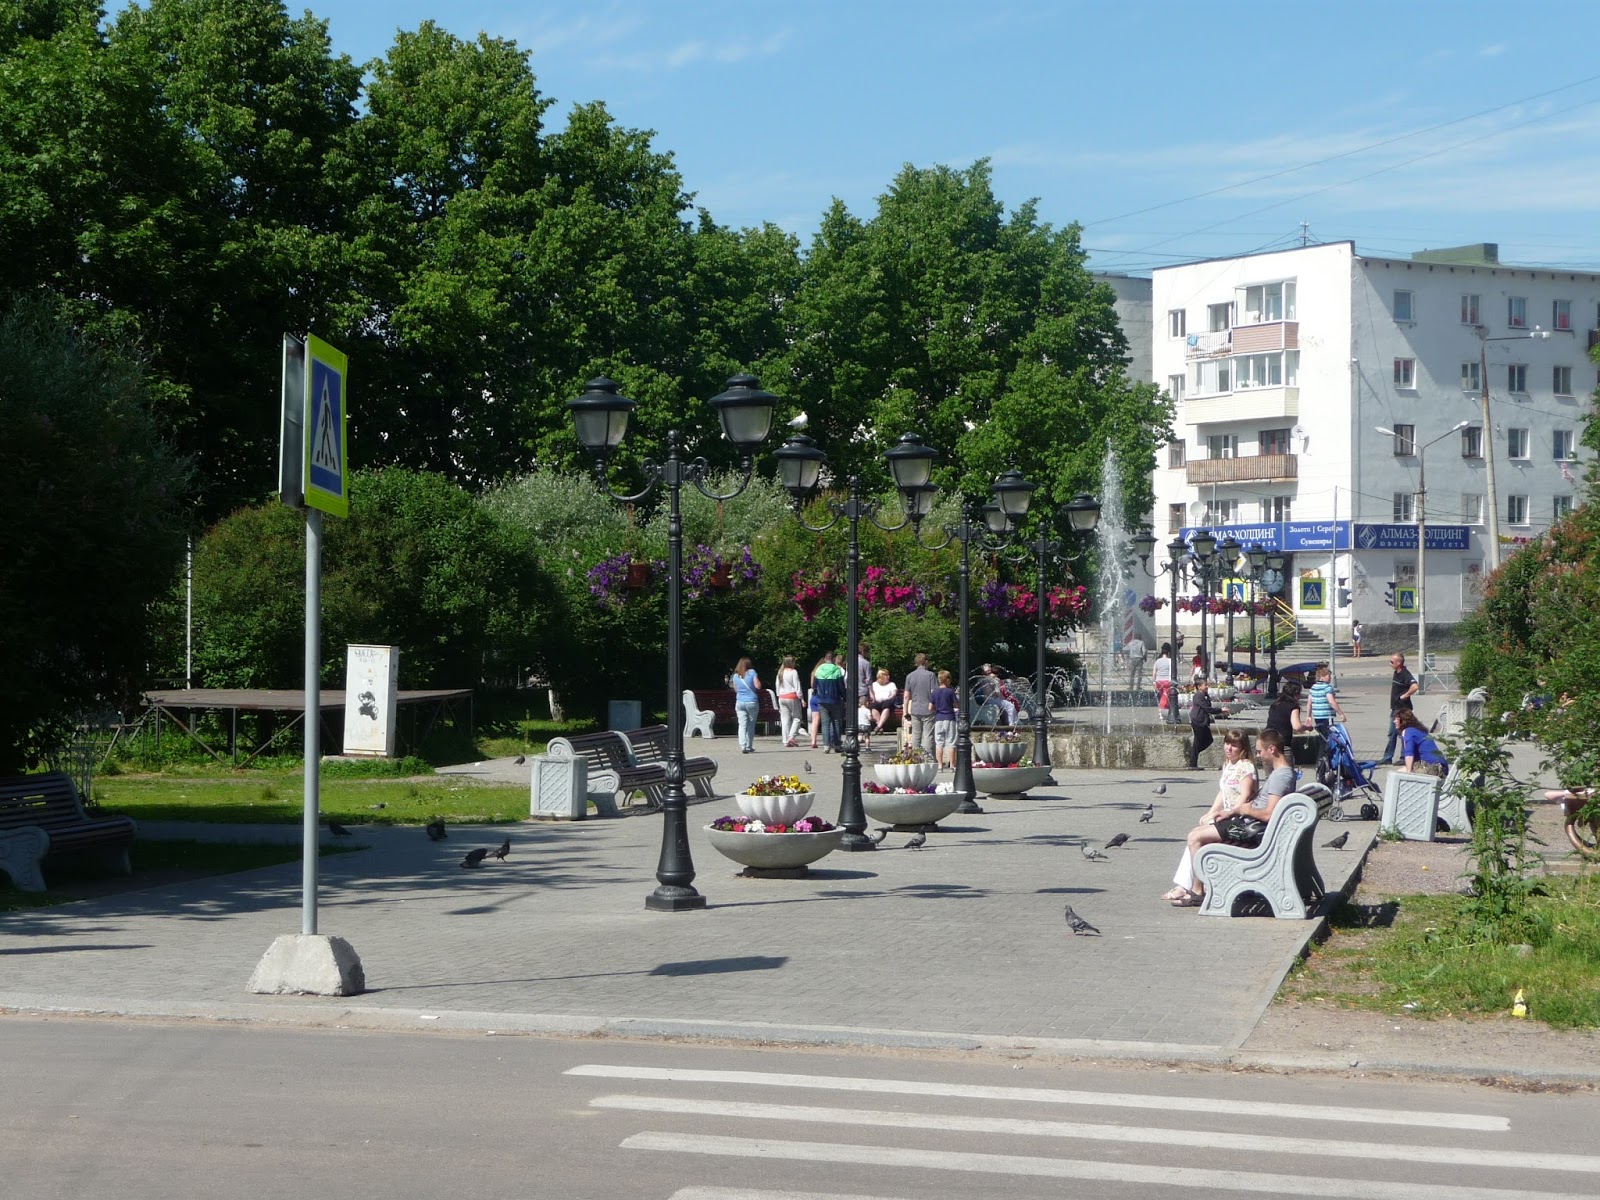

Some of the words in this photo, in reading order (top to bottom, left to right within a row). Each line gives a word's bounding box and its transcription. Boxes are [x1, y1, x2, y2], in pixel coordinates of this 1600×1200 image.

[1206, 527, 1277, 541] ЛМАЗ-ХОЛДИНГ
[1300, 538, 1332, 546] Сувениры
[1380, 541, 1436, 549] ювелирая
